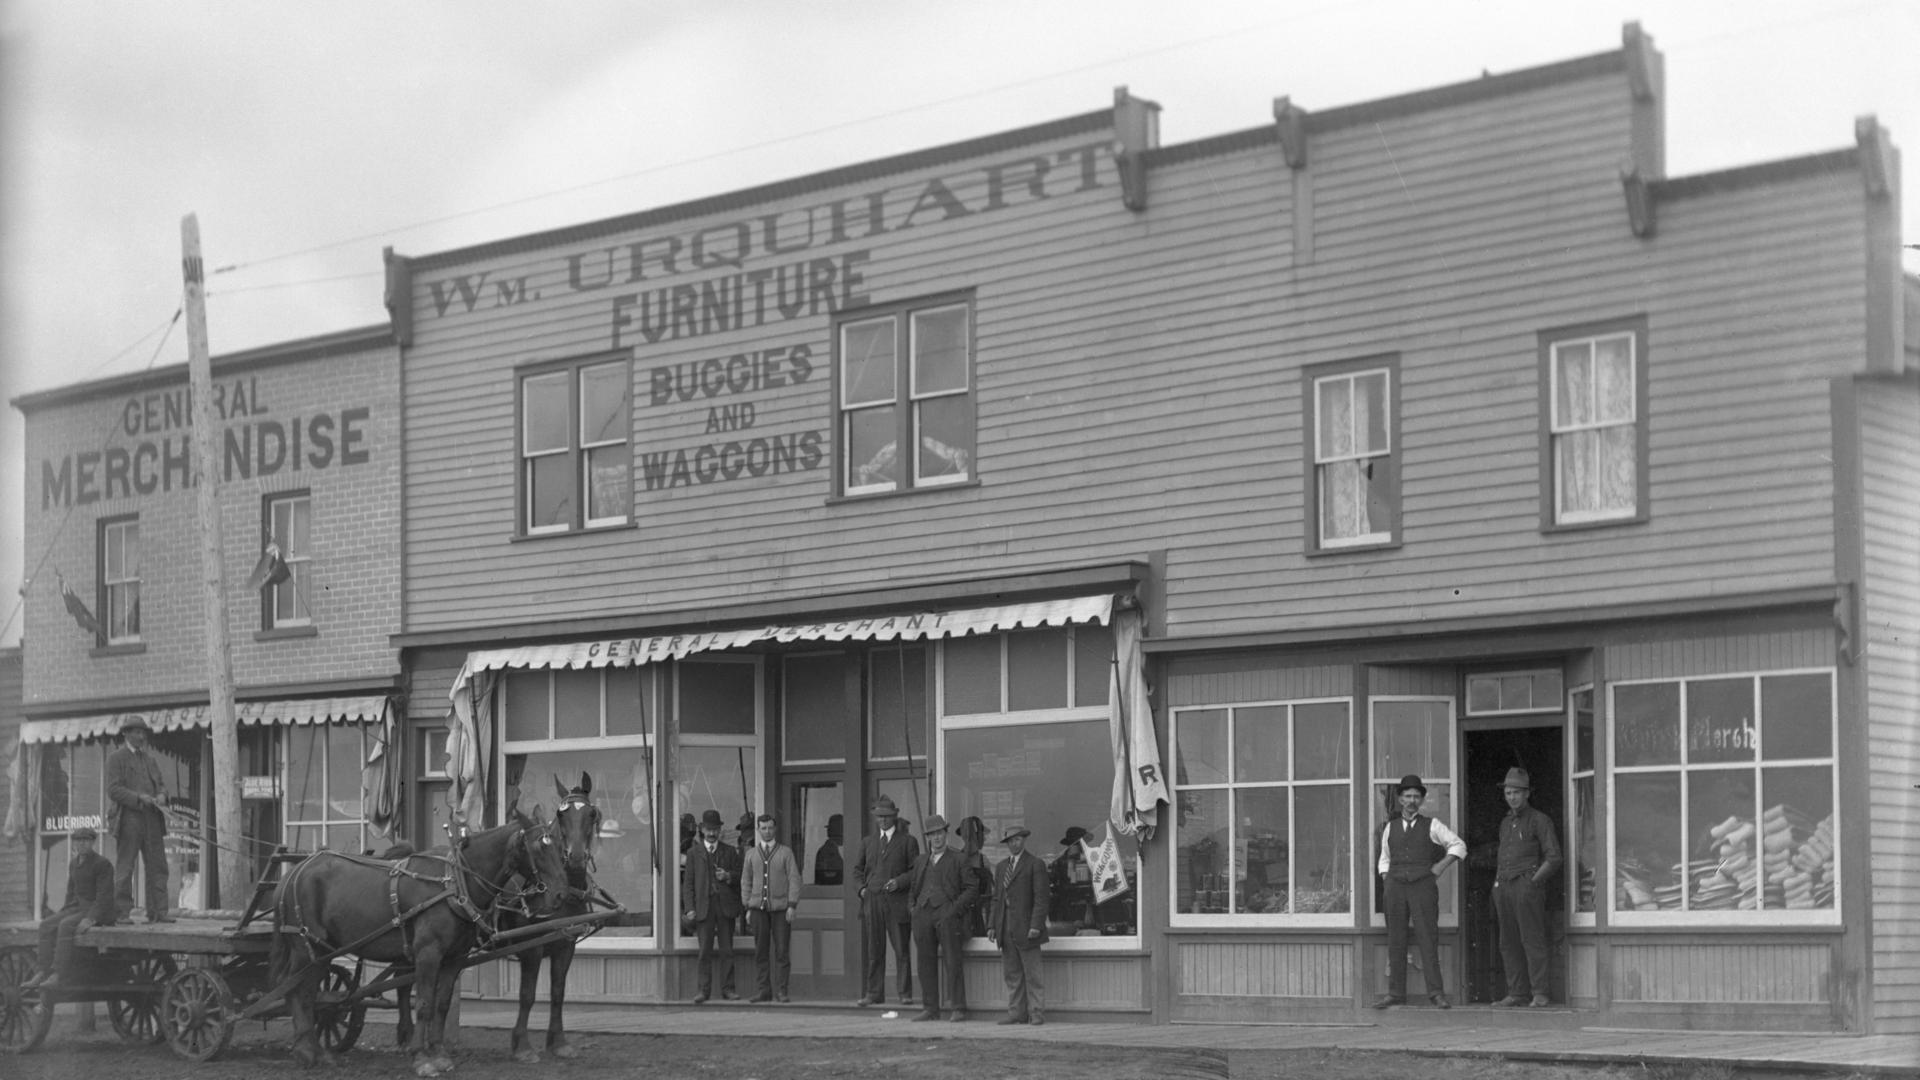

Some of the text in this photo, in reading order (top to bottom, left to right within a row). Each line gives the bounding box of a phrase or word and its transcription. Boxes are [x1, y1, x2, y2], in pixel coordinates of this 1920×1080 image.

[563, 141, 1114, 293] URQUHART
[611, 250, 872, 350] FURNITURE
[650, 343, 813, 407] BUGGIES
[705, 402, 756, 434] AND
[42, 406, 370, 511] MERCHNDISE
[642, 430, 823, 491] WAGGONS
[588, 612, 949, 659] GENERAL MERCHANT
[45, 816, 70, 830] BLUE
[70, 813, 102, 829] RIBBON
